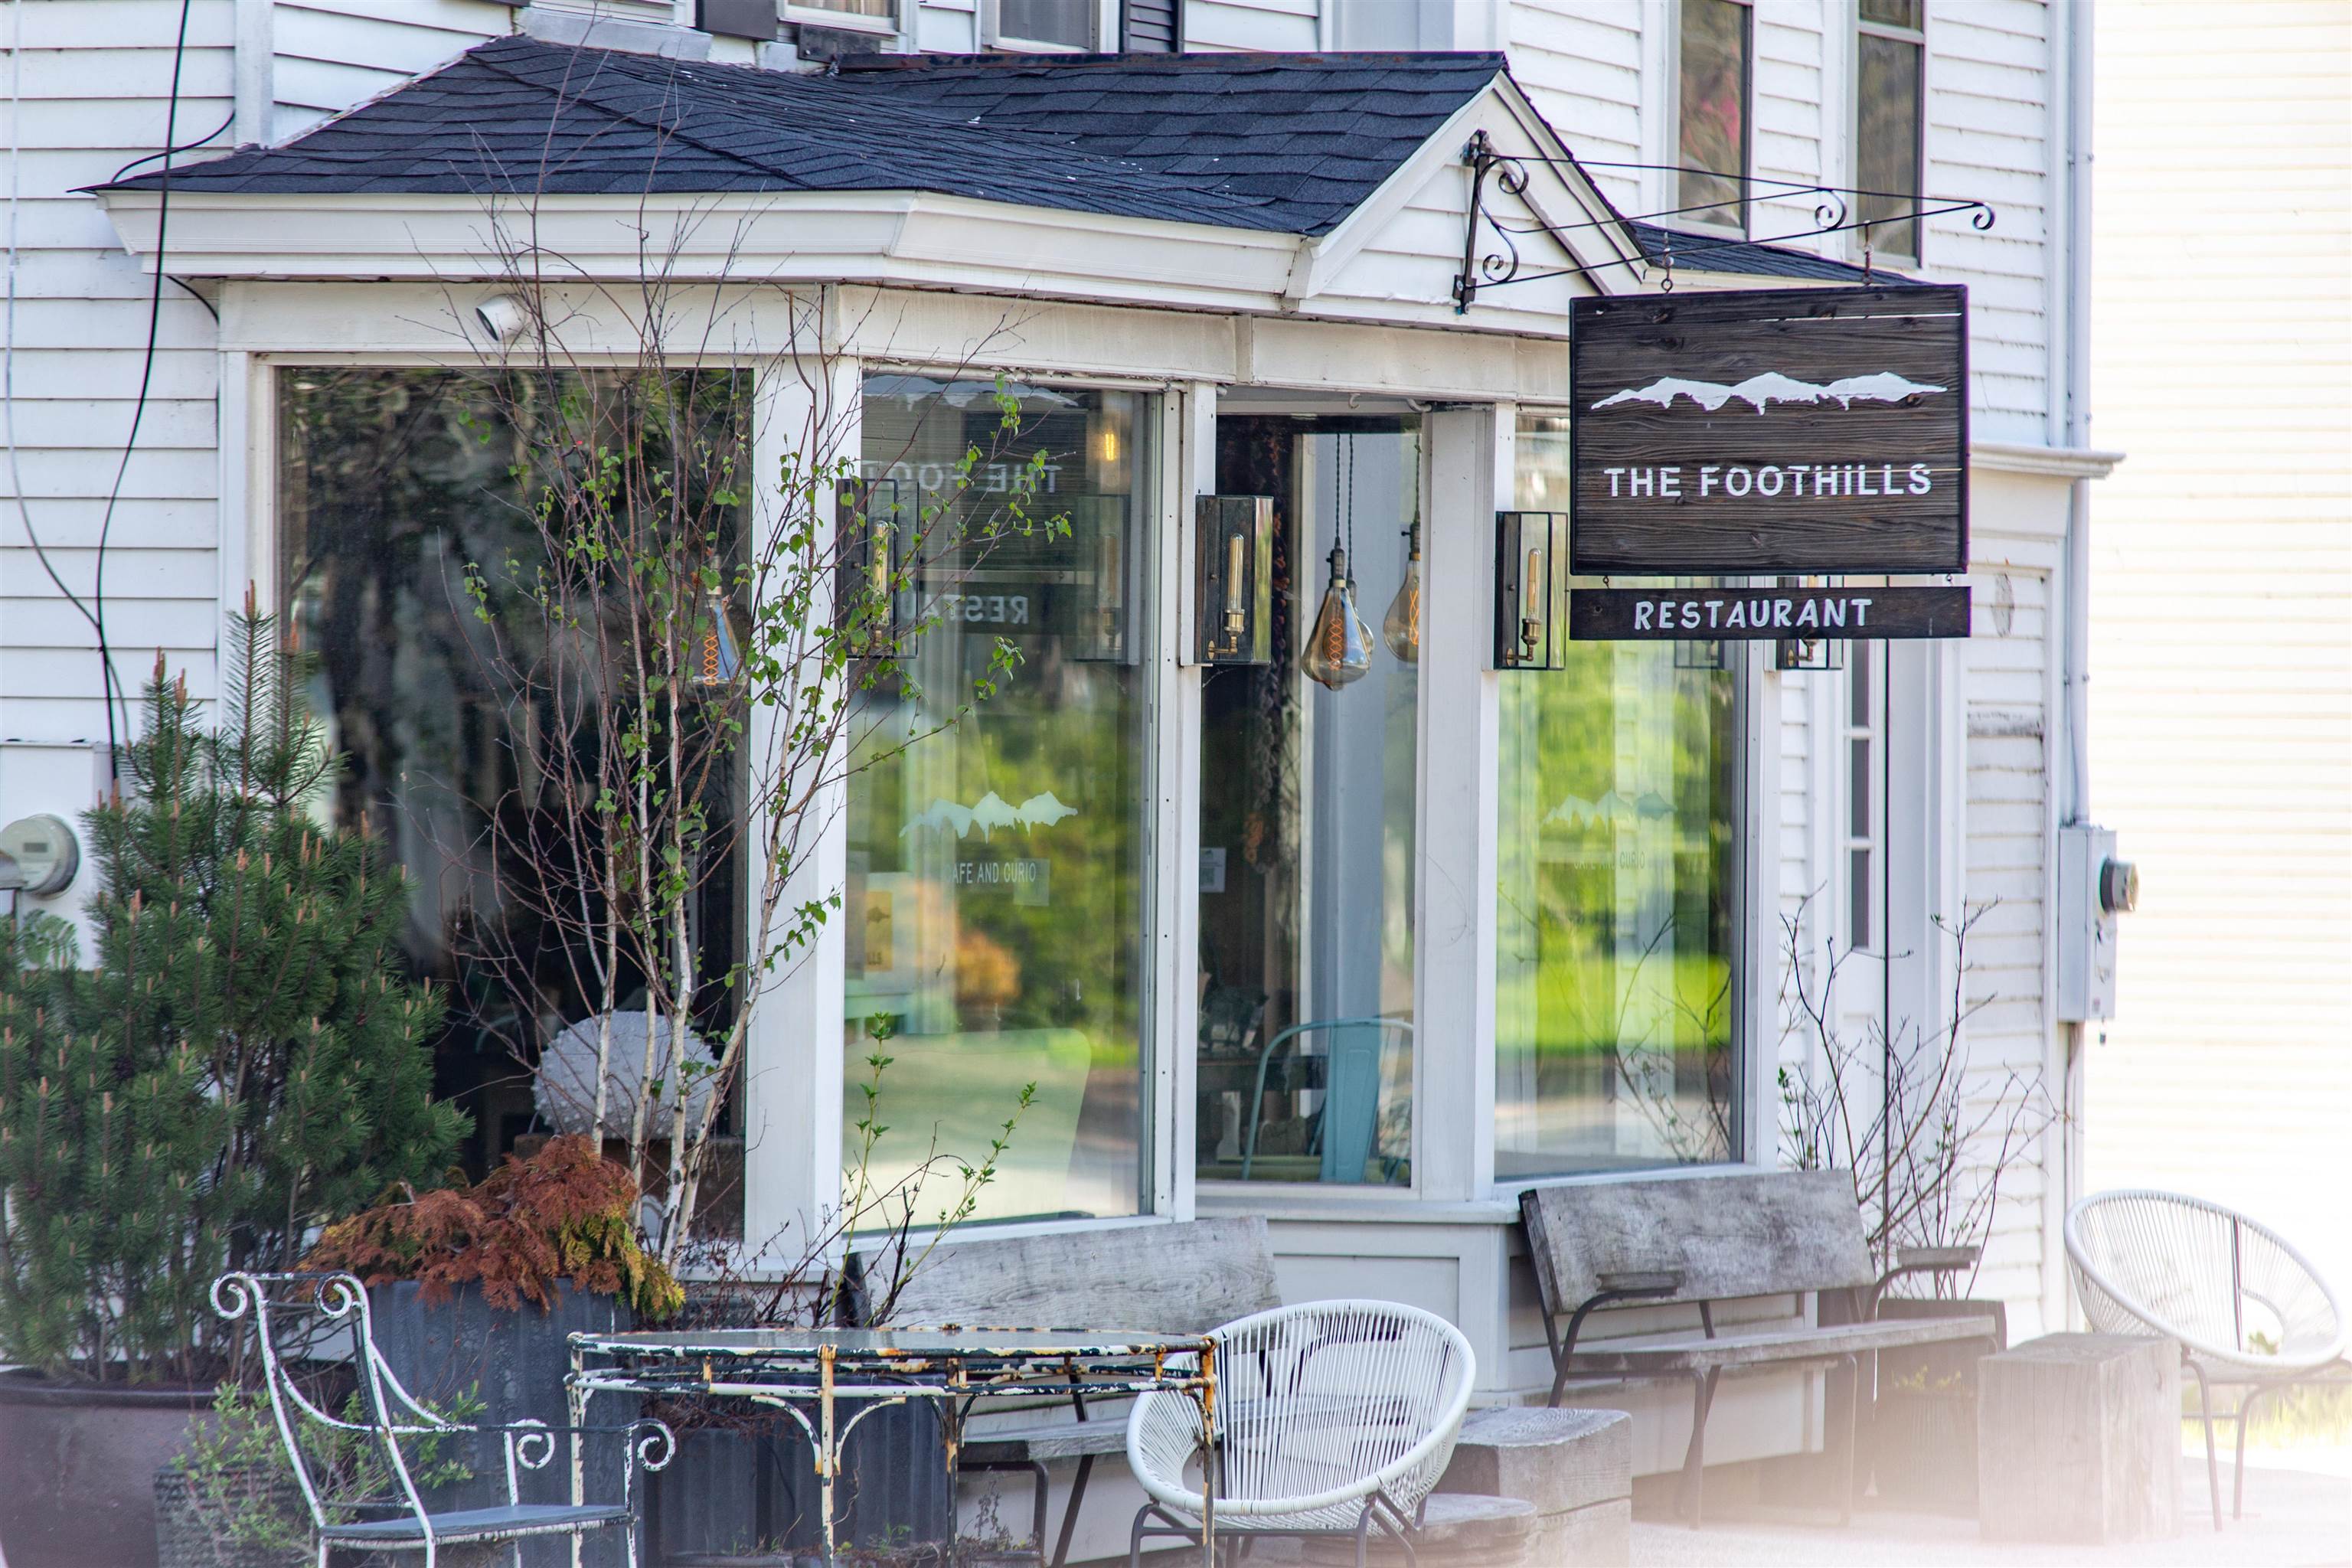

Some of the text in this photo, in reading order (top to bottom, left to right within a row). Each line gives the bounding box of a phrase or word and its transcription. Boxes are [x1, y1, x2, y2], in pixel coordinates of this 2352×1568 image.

[1603, 463, 1932, 498] THE FOOTHILLS
[1634, 598, 1873, 630] RESTAURANT
[977, 862, 999, 884] AND
[1003, 862, 1036, 883] CURIO
